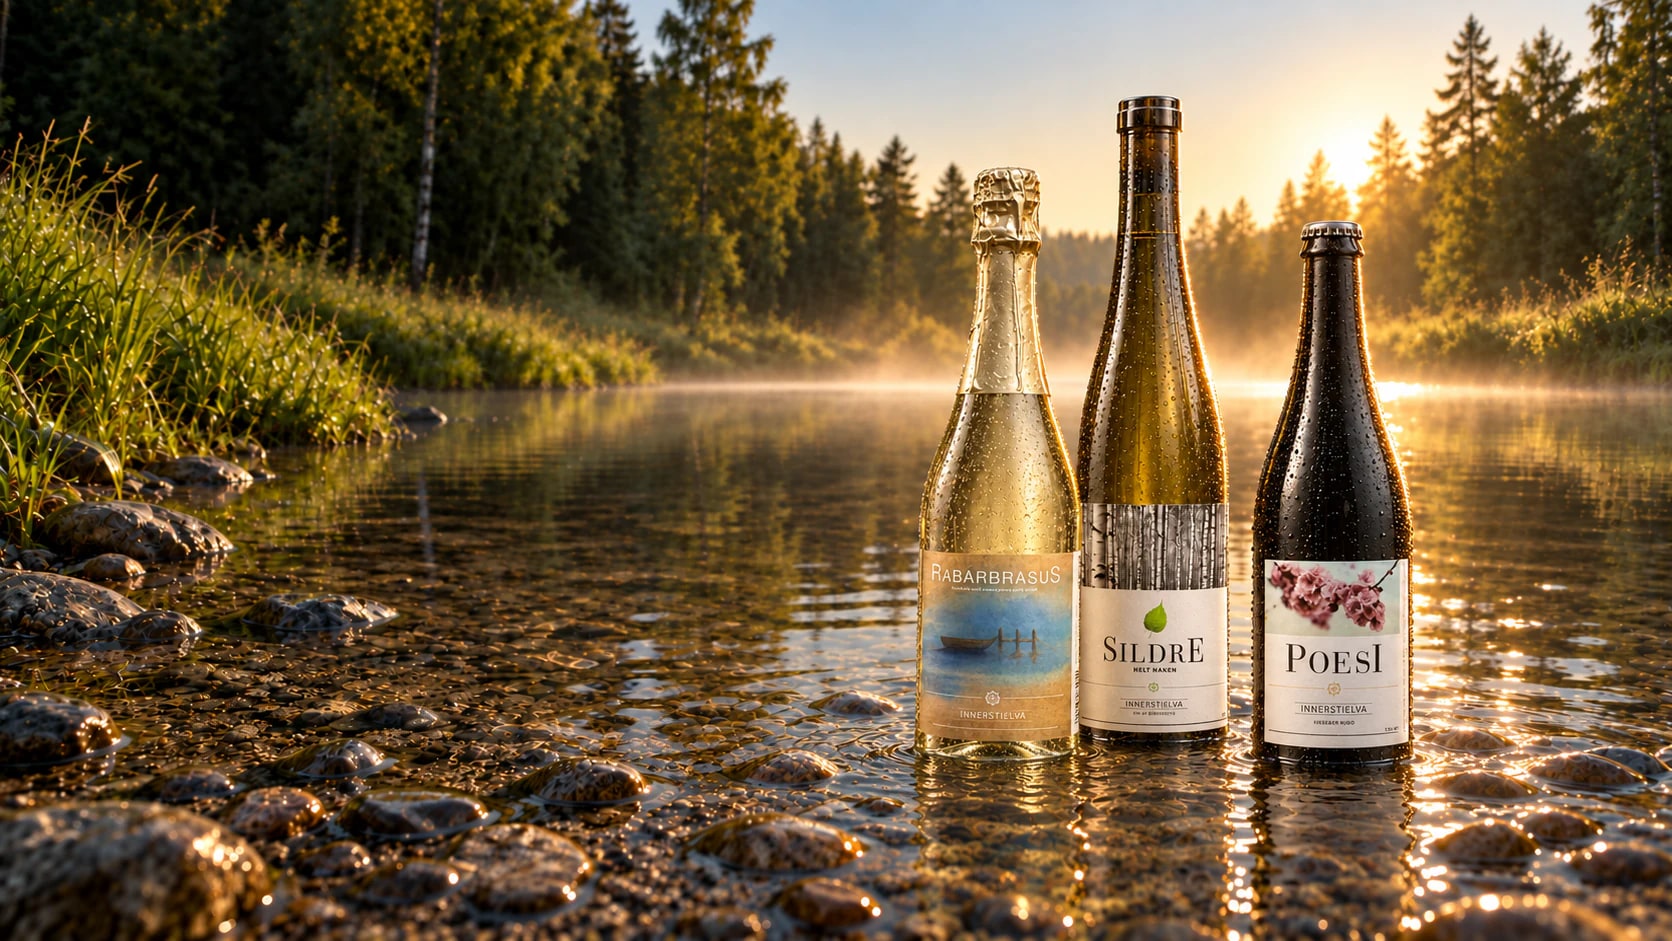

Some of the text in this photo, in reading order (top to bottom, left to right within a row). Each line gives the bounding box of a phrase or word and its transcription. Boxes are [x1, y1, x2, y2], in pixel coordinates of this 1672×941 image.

[931, 563, 1061, 585] RABARBRASUS
[1103, 635, 1204, 663] SILDRE
[1285, 643, 1382, 674] POESI
[1125, 700, 1183, 708] INNERSTIELVA
[1300, 705, 1367, 713] INNERSTIELVA
[960, 710, 1026, 719] INNERSTIELVA
